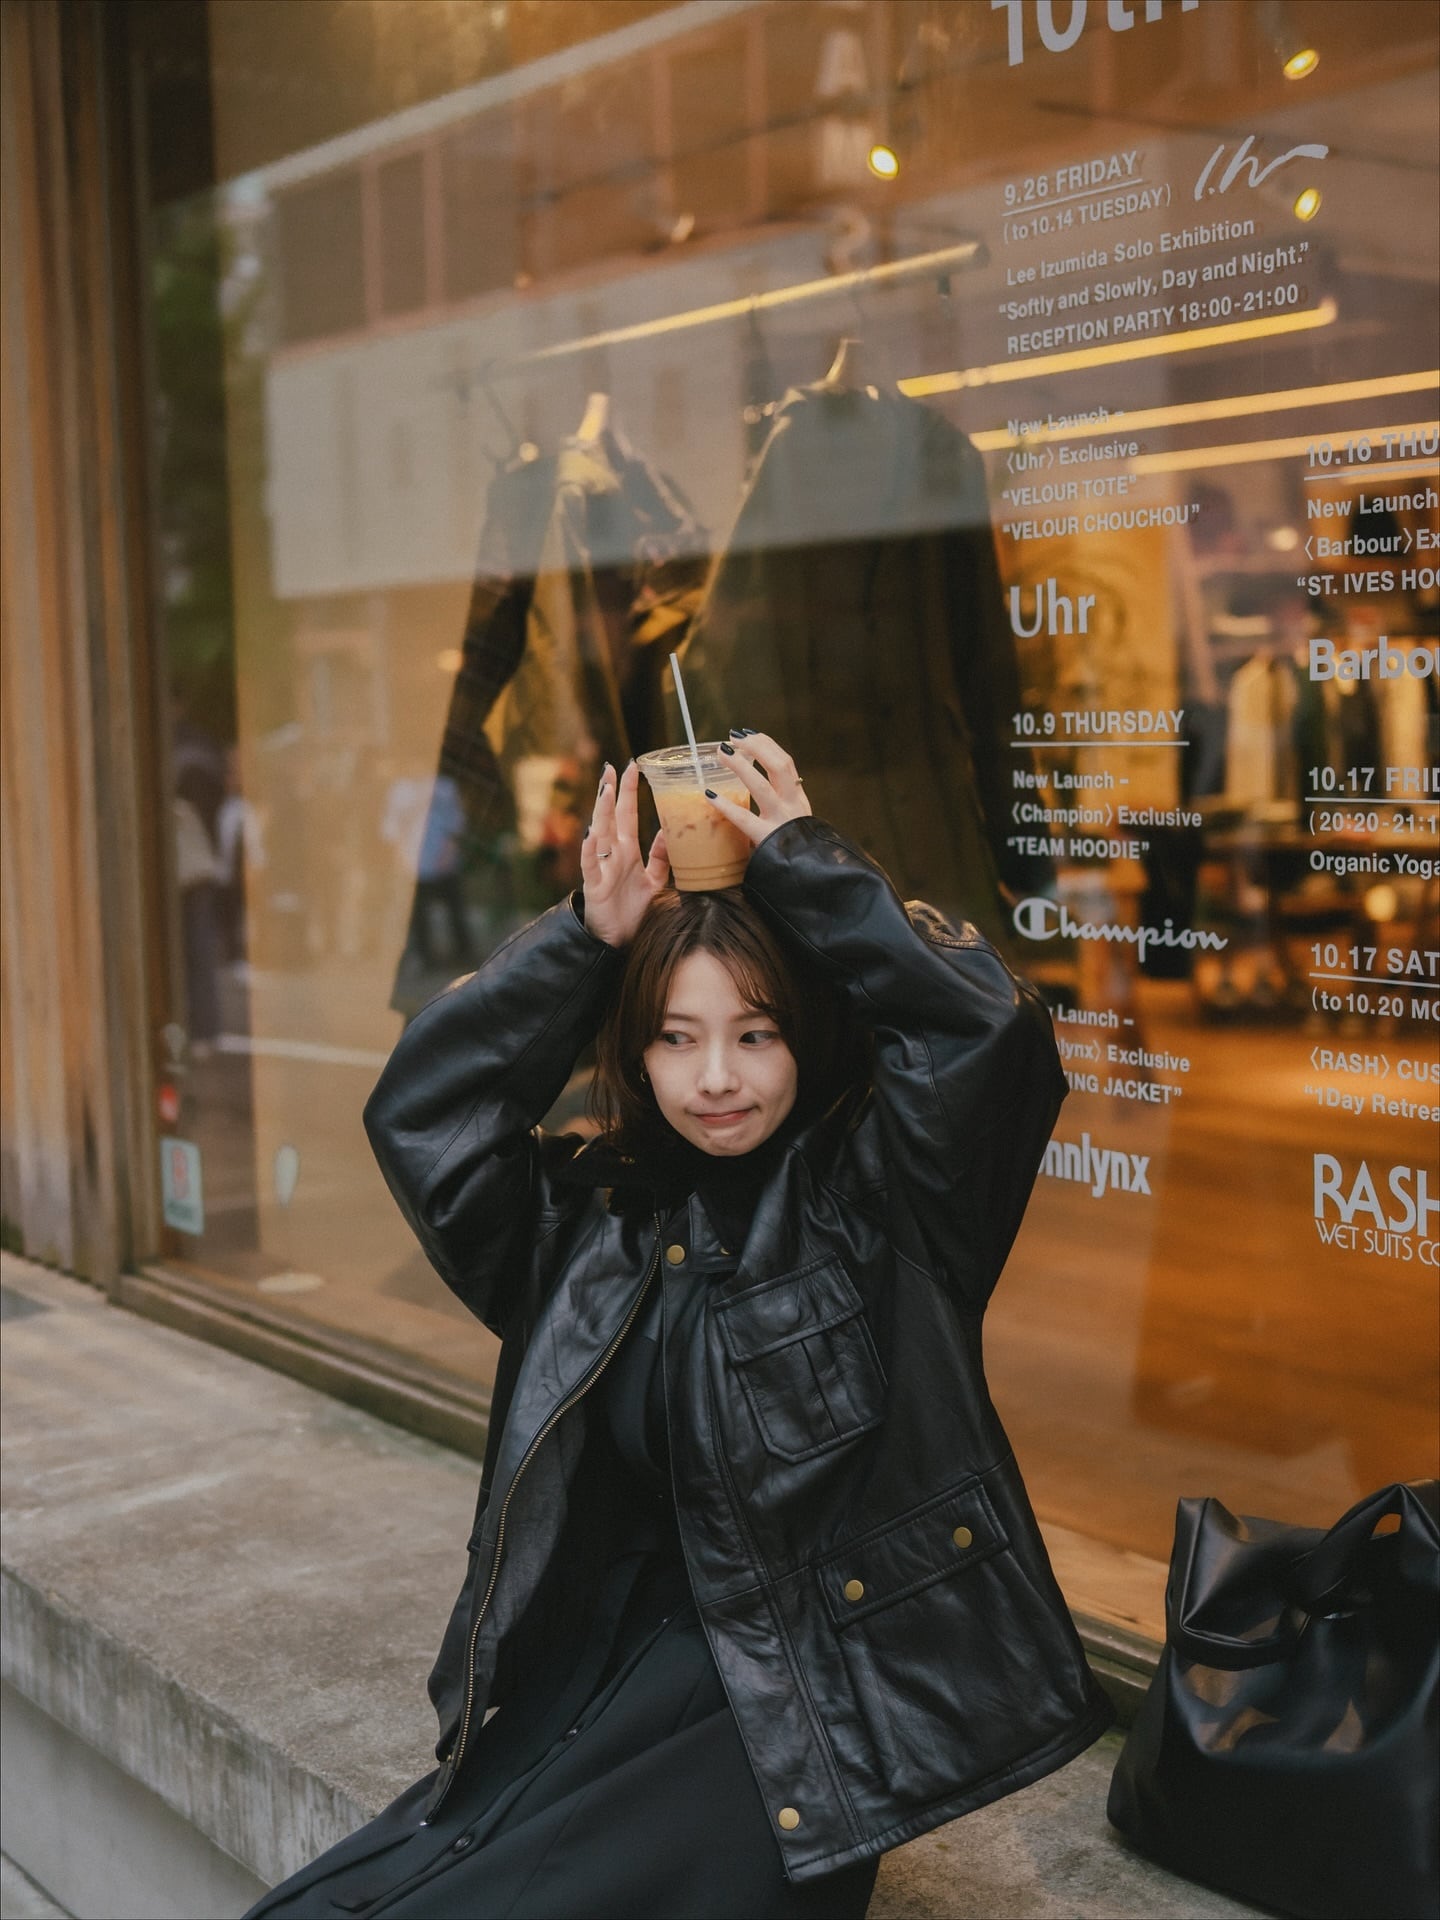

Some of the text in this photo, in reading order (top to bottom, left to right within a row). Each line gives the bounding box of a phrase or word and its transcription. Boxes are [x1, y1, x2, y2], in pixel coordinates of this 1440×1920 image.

[991, 0, 1199, 67] 10
[1004, 150, 1137, 206] 9.26 FRIDAY
[1031, 209, 1073, 235] 10.14
[1078, 184, 1171, 224] TUESDAY)
[1007, 220, 1254, 287] Lee Izumida Solo Exhibition
[1058, 289, 1089, 311] and
[1094, 276, 1157, 303] Slowly,
[1162, 267, 1197, 290] Day
[1202, 257, 1237, 282] and
[1007, 318, 1108, 355] RECEPTION
[1113, 306, 1175, 336] PARTY
[1007, 418, 1042, 437] New
[1048, 406, 1109, 432] Launch
[1059, 440, 1139, 465] Exclusive
[1306, 428, 1439, 467] 10.16 THU
[1307, 487, 1438, 519] New Launch
[1344, 570, 1394, 594] IVES
[1401, 567, 1440, 591] HO
[1010, 578, 1096, 638] Uhr
[1308, 635, 1440, 682] Barbo
[1012, 710, 1185, 736] 10.9 THURSDAY
[1013, 771, 1048, 789] New
[1053, 770, 1114, 790] Launch
[1308, 766, 1375, 792] 10.17
[1118, 805, 1202, 828] Exclusive
[1309, 850, 1390, 876] Organic
[1012, 897, 1229, 963] Champion
[1311, 943, 1440, 977] 10.17 SAT
[1057, 1003, 1119, 1029] Launch
[1346, 993, 1404, 1018] 10.20
[1107, 1044, 1191, 1073] Exclusive
[1063, 1070, 1099, 1093] ING
[1372, 1093, 1440, 1123] Retrea
[1038, 1132, 1152, 1198] nnlynx
[1313, 1153, 1440, 1238] RASH
[1315, 1219, 1359, 1250] WET
[1363, 1228, 1413, 1262] SUITS
